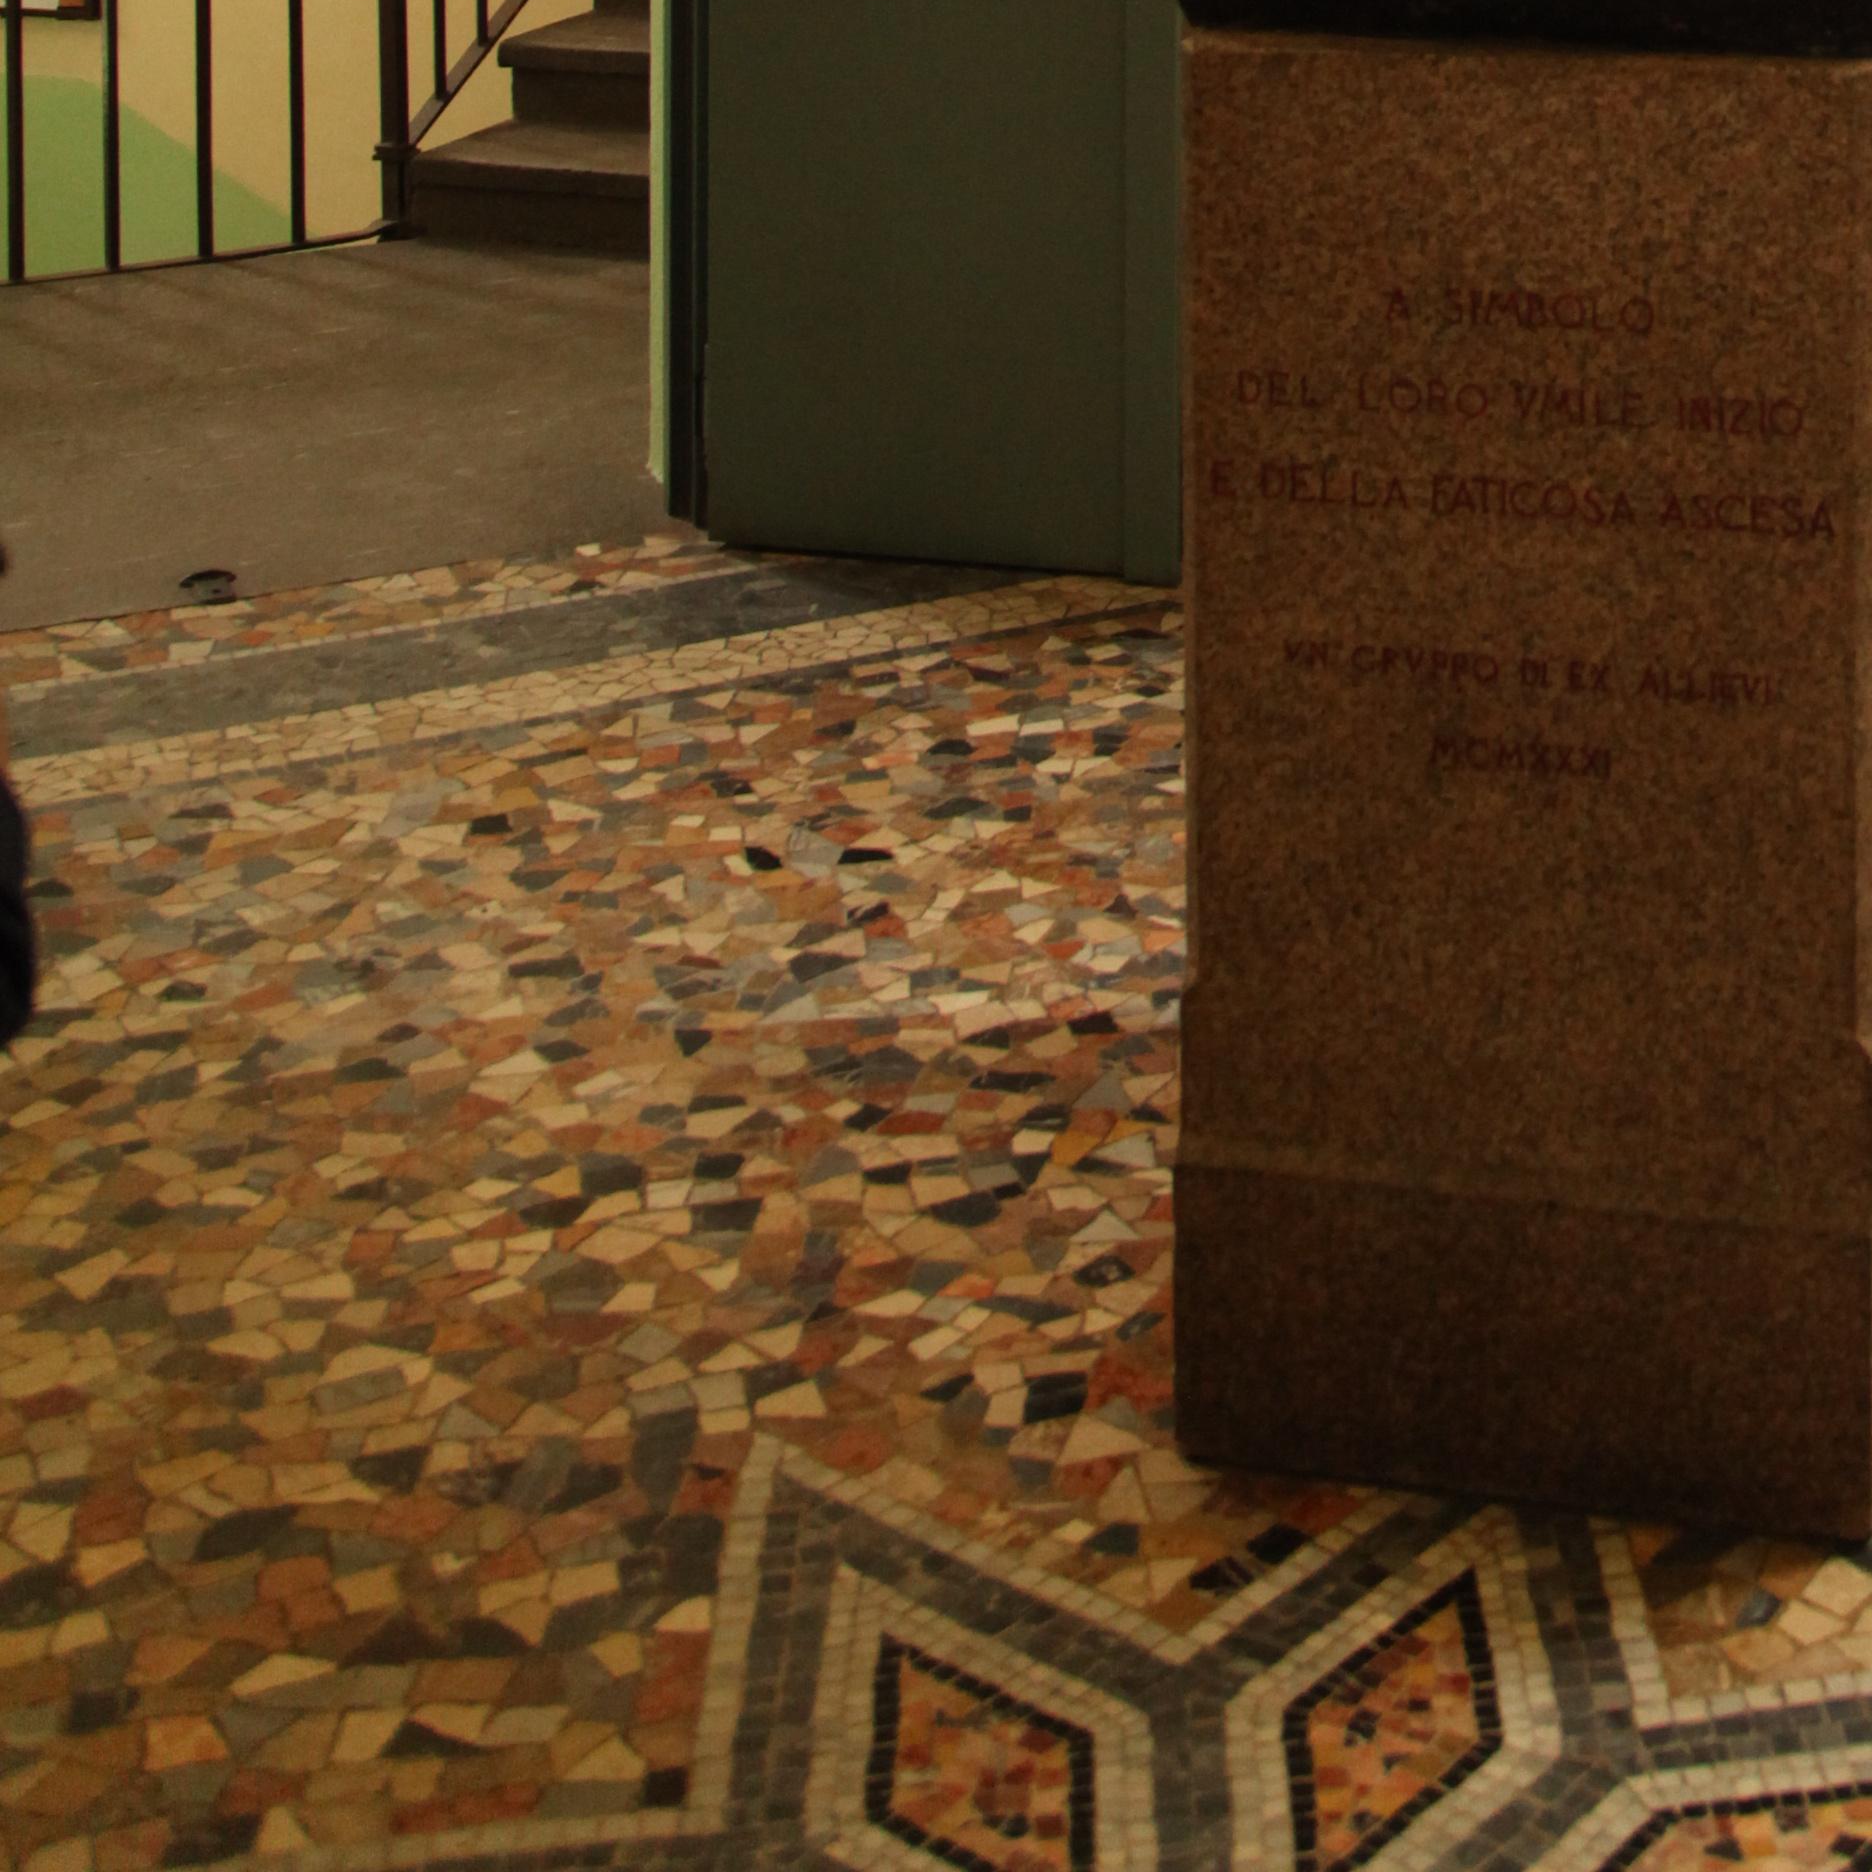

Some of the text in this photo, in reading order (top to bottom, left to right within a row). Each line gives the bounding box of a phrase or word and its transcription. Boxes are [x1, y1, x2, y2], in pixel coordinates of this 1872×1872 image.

[1443, 287, 1656, 336] SIMBOLO
[1236, 369, 1320, 409] DEL
[1358, 372, 1490, 419] LORO
[1678, 396, 1806, 438] INIZIO
[1210, 459, 1837, 539] E DELLA FATICOSA ASCESA
